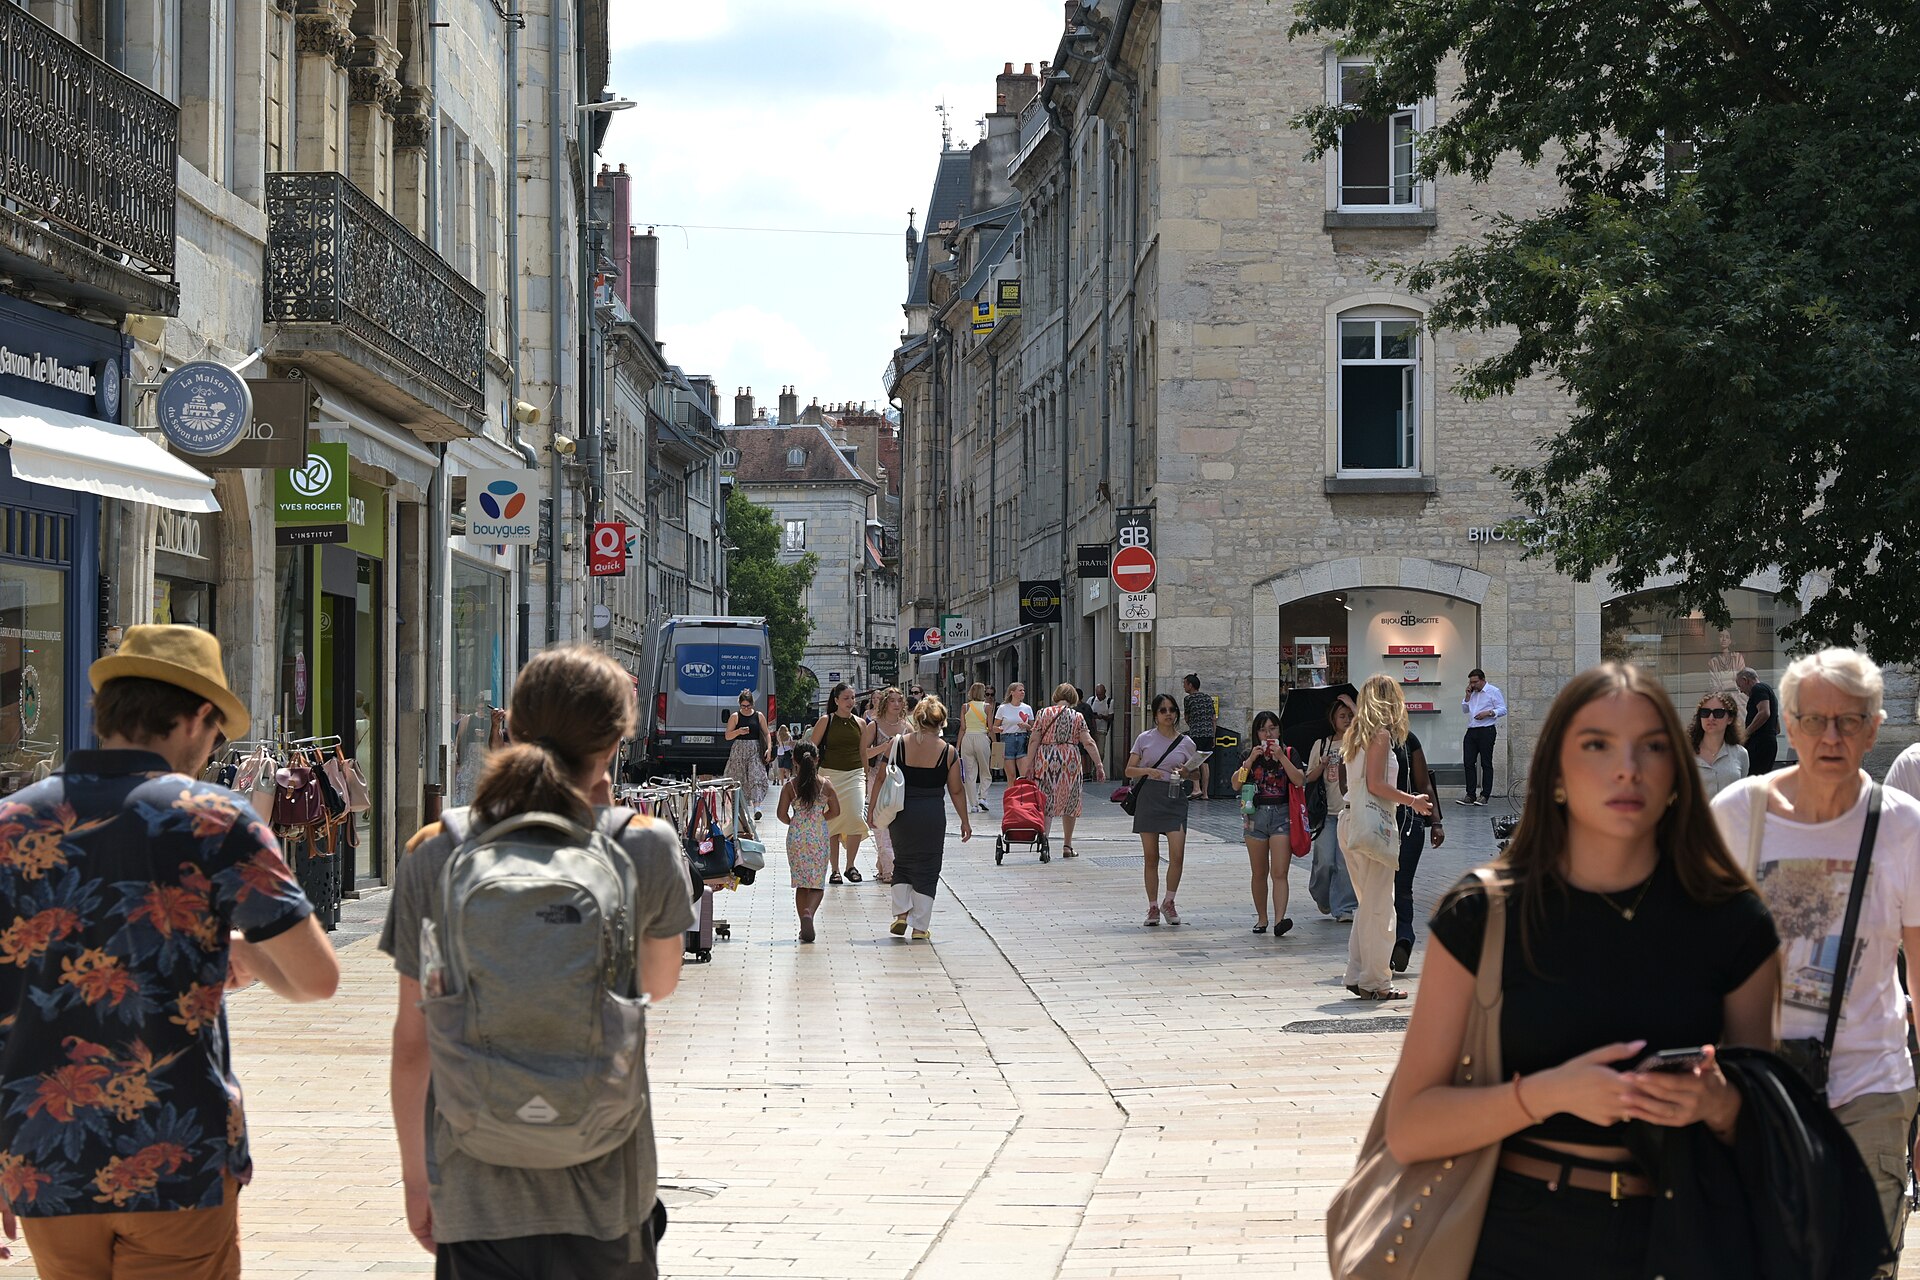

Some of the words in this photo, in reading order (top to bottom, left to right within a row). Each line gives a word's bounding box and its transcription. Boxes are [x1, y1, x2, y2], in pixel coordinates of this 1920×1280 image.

[0, 346, 31, 379] Savon
[33, 352, 46, 382] de
[47, 357, 97, 396] Marseille
[180, 378, 193, 389] La
[195, 373, 230, 394] Maison
[168, 406, 176, 419] du
[170, 419, 191, 440] Savon
[204, 412, 236, 443] Marseille
[192, 434, 203, 443] de
[280, 503, 302, 511] YVES
[304, 503, 342, 511] ROCHER
[290, 531, 333, 539] L'INSTITUT
[473, 522, 531, 539] bouygues
[595, 560, 621, 572] Quick
[1078, 559, 1109, 567] STRATUS
[1127, 594, 1148, 602] SAUF
[948, 629, 969, 638] avril
[909, 641, 929, 651] AXA
[685, 664, 710, 674] PVC
